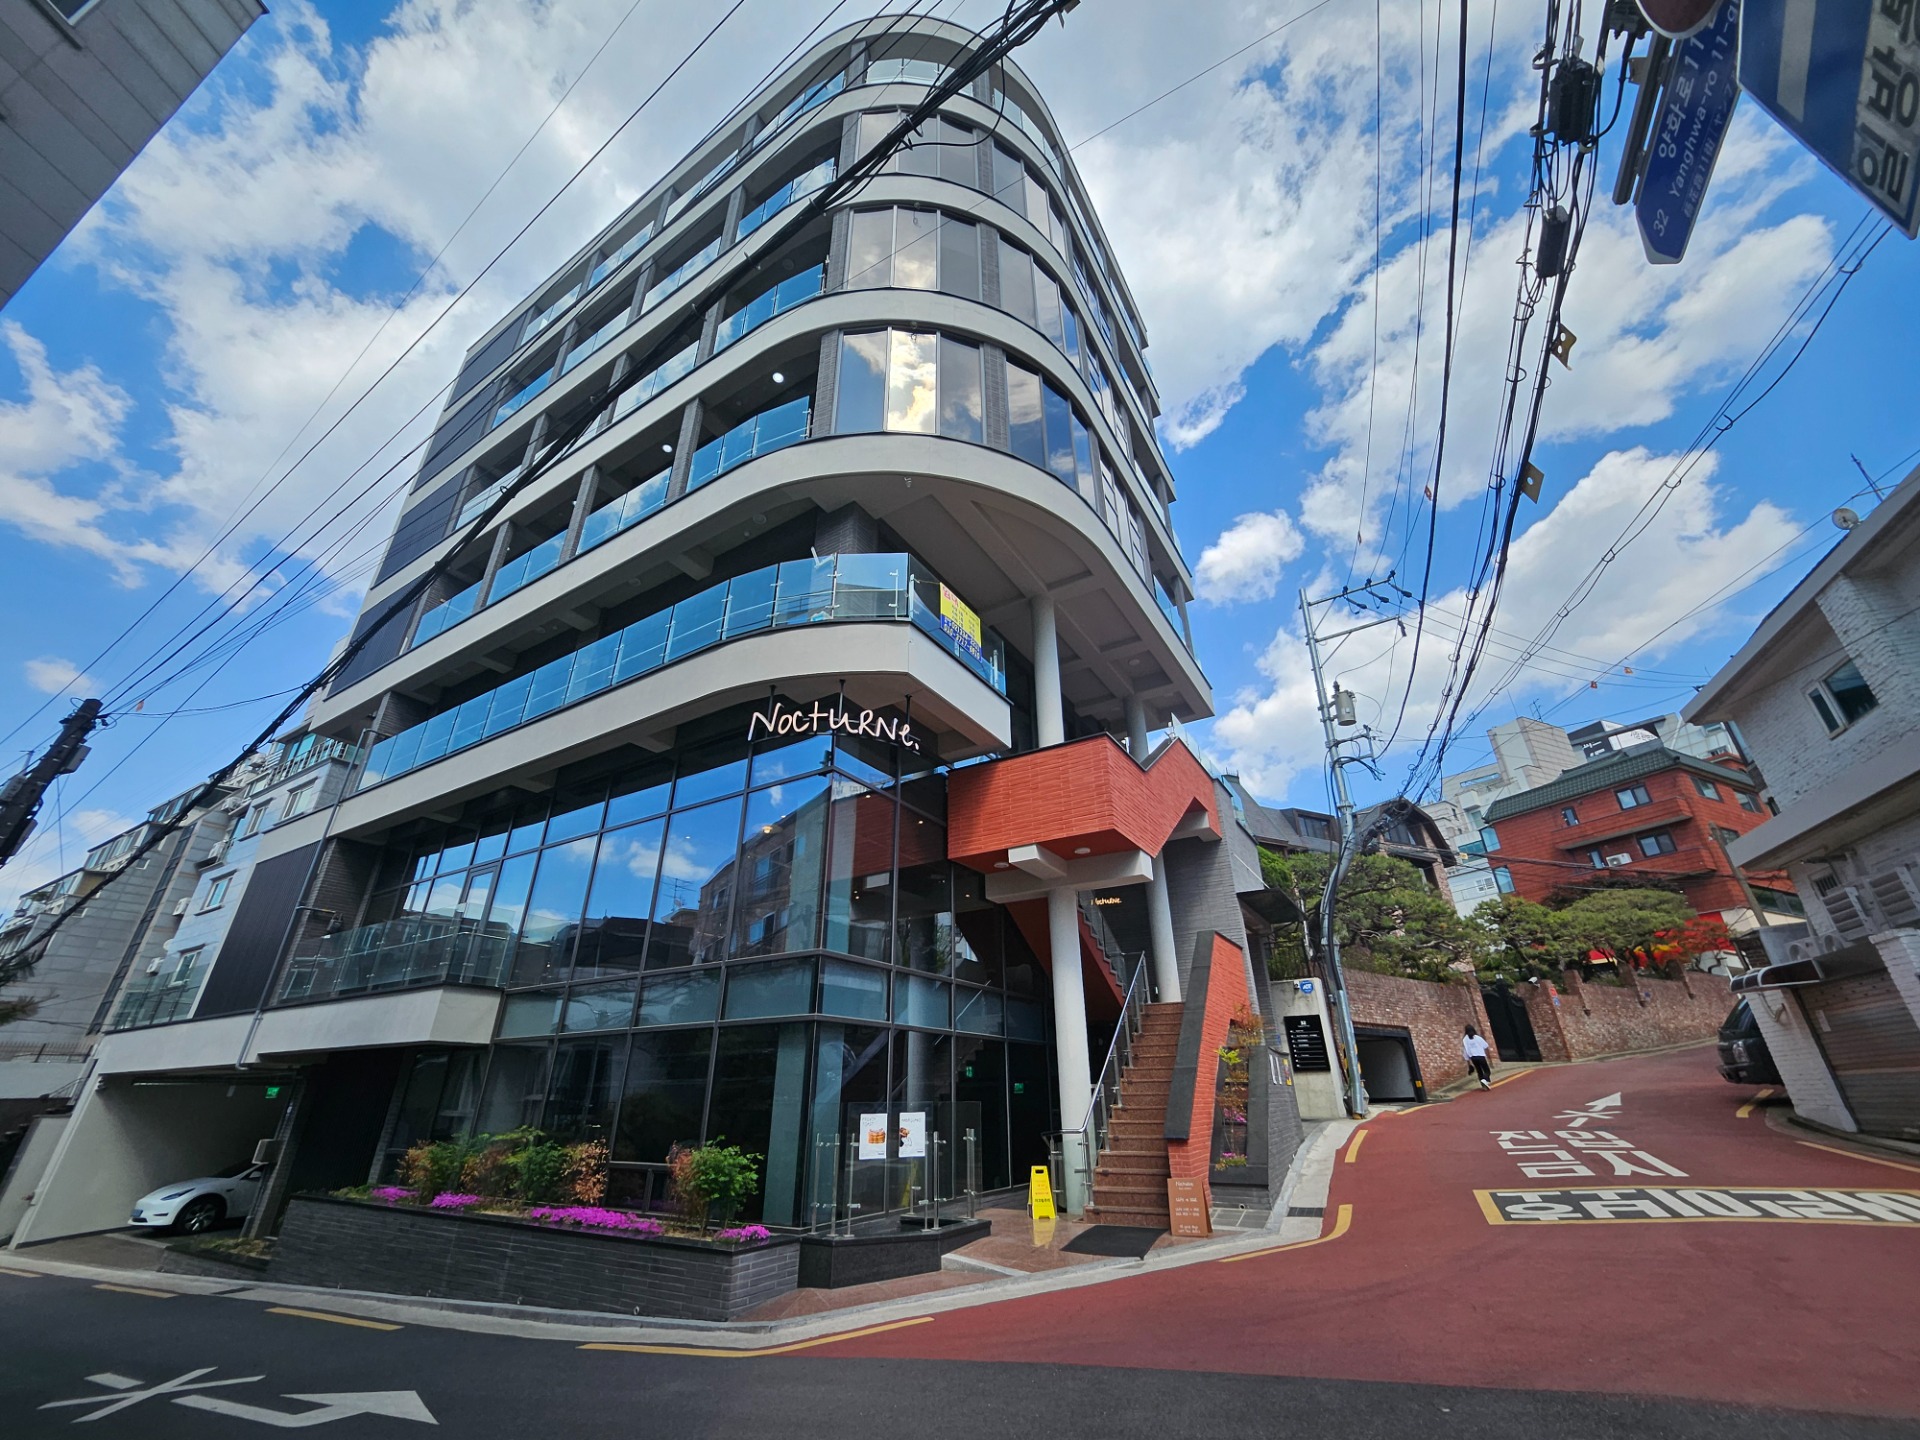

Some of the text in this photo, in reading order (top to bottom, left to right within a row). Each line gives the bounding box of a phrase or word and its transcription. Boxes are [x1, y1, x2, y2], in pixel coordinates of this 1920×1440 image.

[1658, 22, 1717, 159] 양화로11
[1669, 70, 1717, 197] Yanghwa-ro
[1653, 208, 1669, 237] 32
[1490, 1130, 1636, 1149] 진입
[1507, 1149, 1690, 1179] 금지
